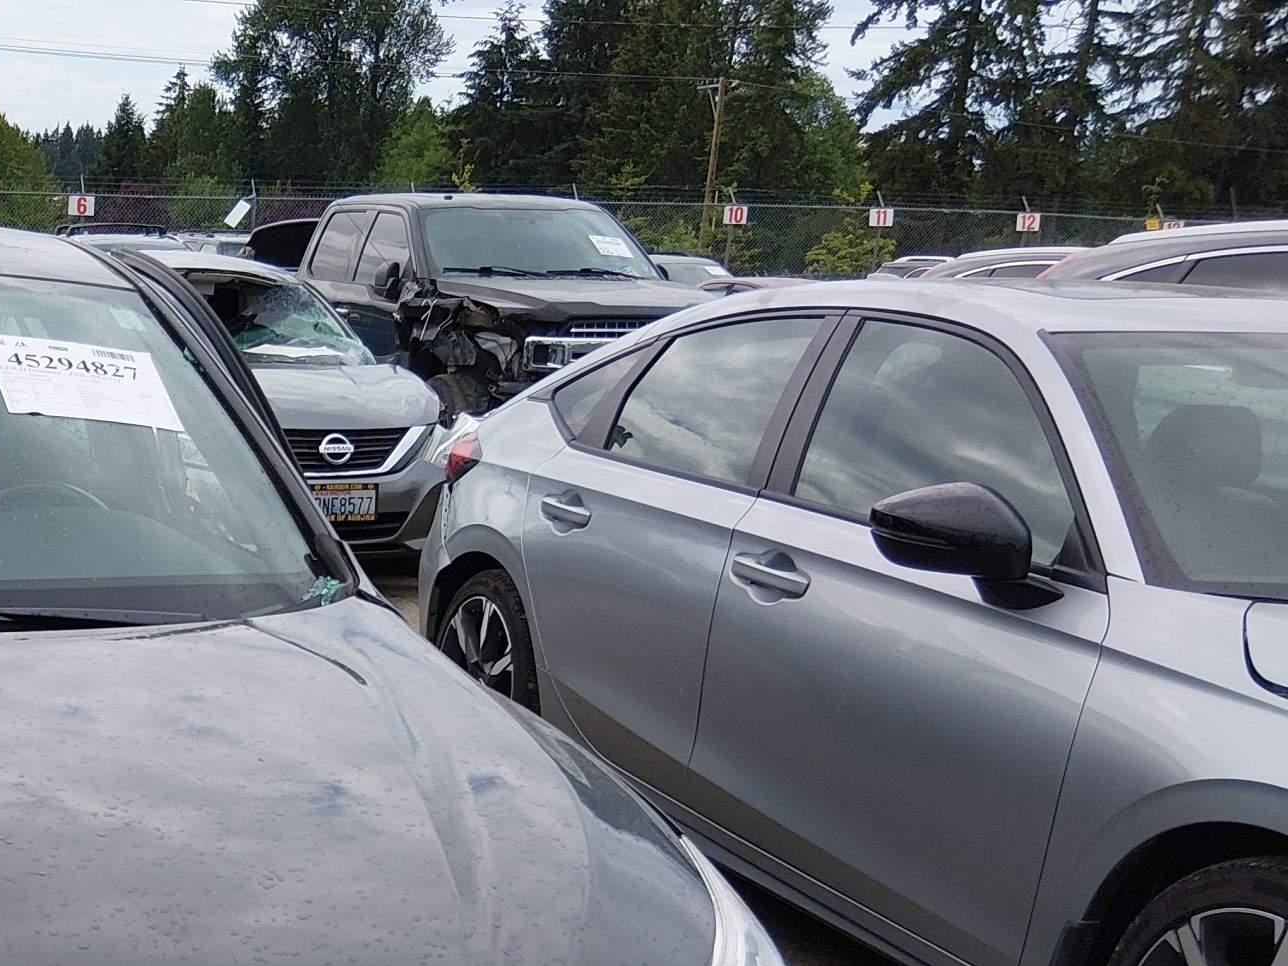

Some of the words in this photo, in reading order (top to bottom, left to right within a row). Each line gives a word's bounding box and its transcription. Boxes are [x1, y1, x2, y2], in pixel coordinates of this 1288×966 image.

[76, 197, 88, 215] 6
[727, 206, 744, 224] 10
[875, 209, 888, 226] 11
[1020, 214, 1037, 231] 12
[7, 352, 137, 381] 45294827
